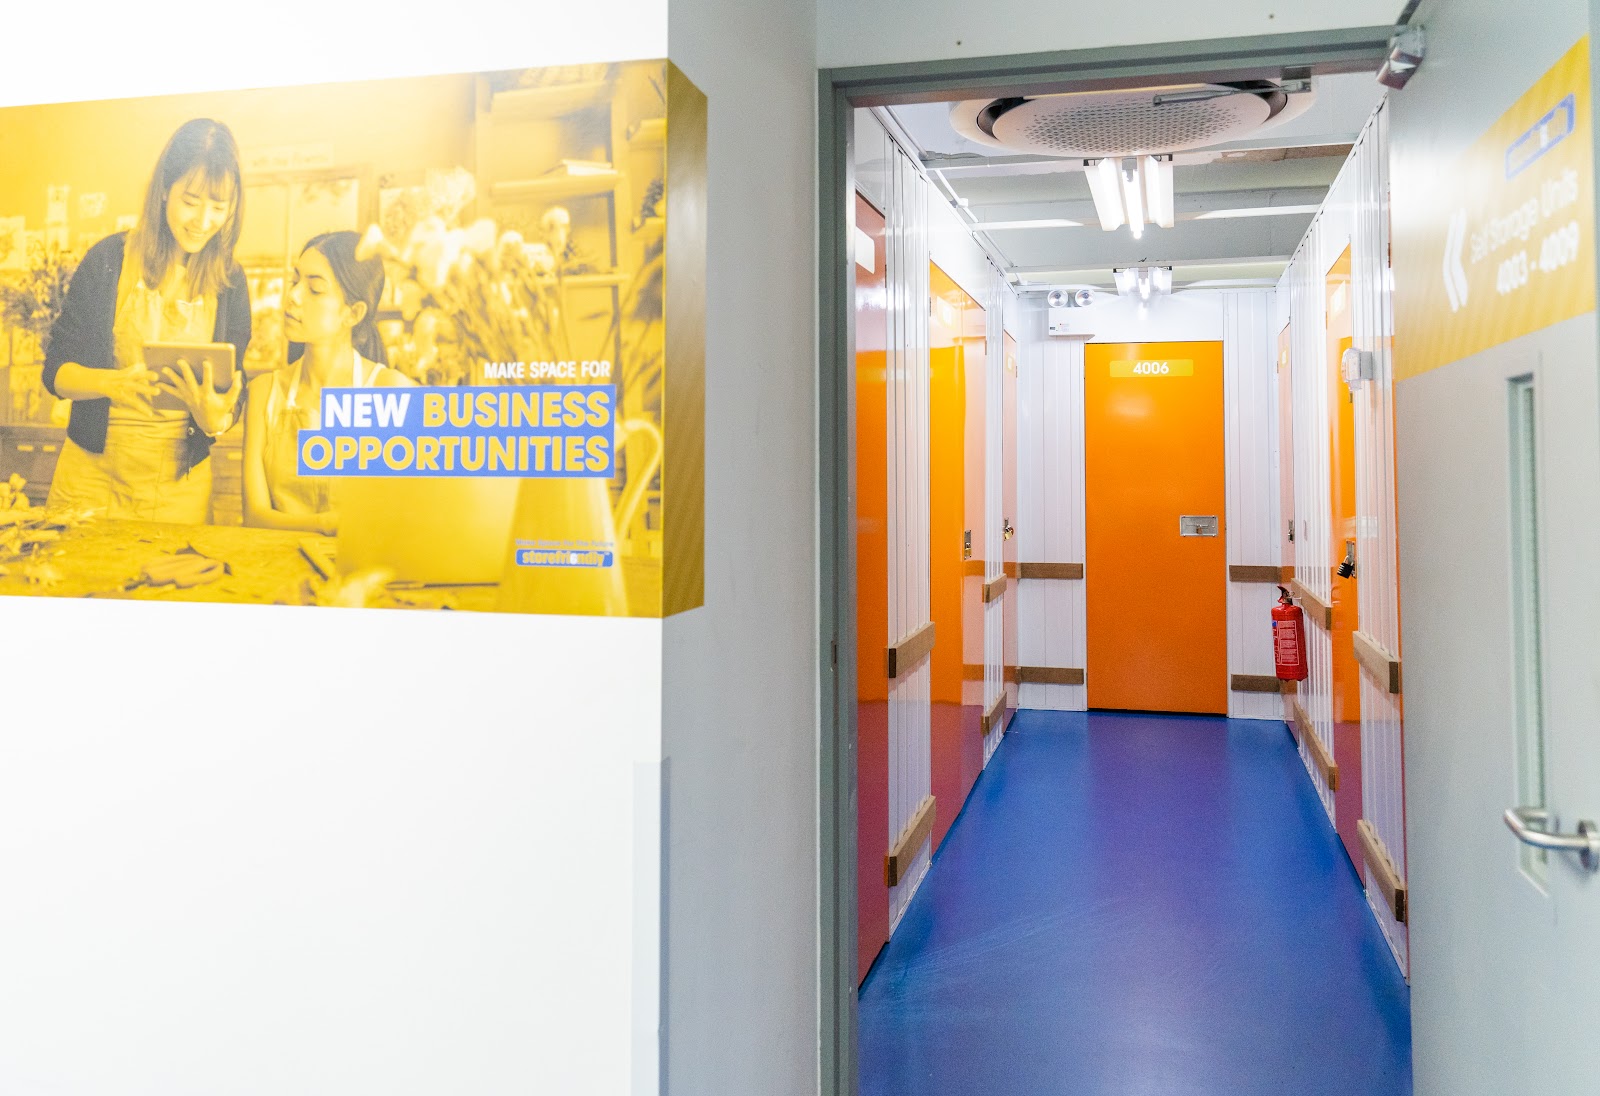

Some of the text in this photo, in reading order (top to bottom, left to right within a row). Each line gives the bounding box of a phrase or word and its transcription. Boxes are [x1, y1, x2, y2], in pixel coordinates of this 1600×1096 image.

[1490, 197, 1538, 253] Storage
[1541, 167, 1578, 219] Units
[484, 360, 611, 379] MAKE SPACE FOR
[1133, 362, 1170, 375] 4006
[325, 391, 610, 428] NEW BUSINESS
[302, 435, 610, 472] OPPORTUNITIES
